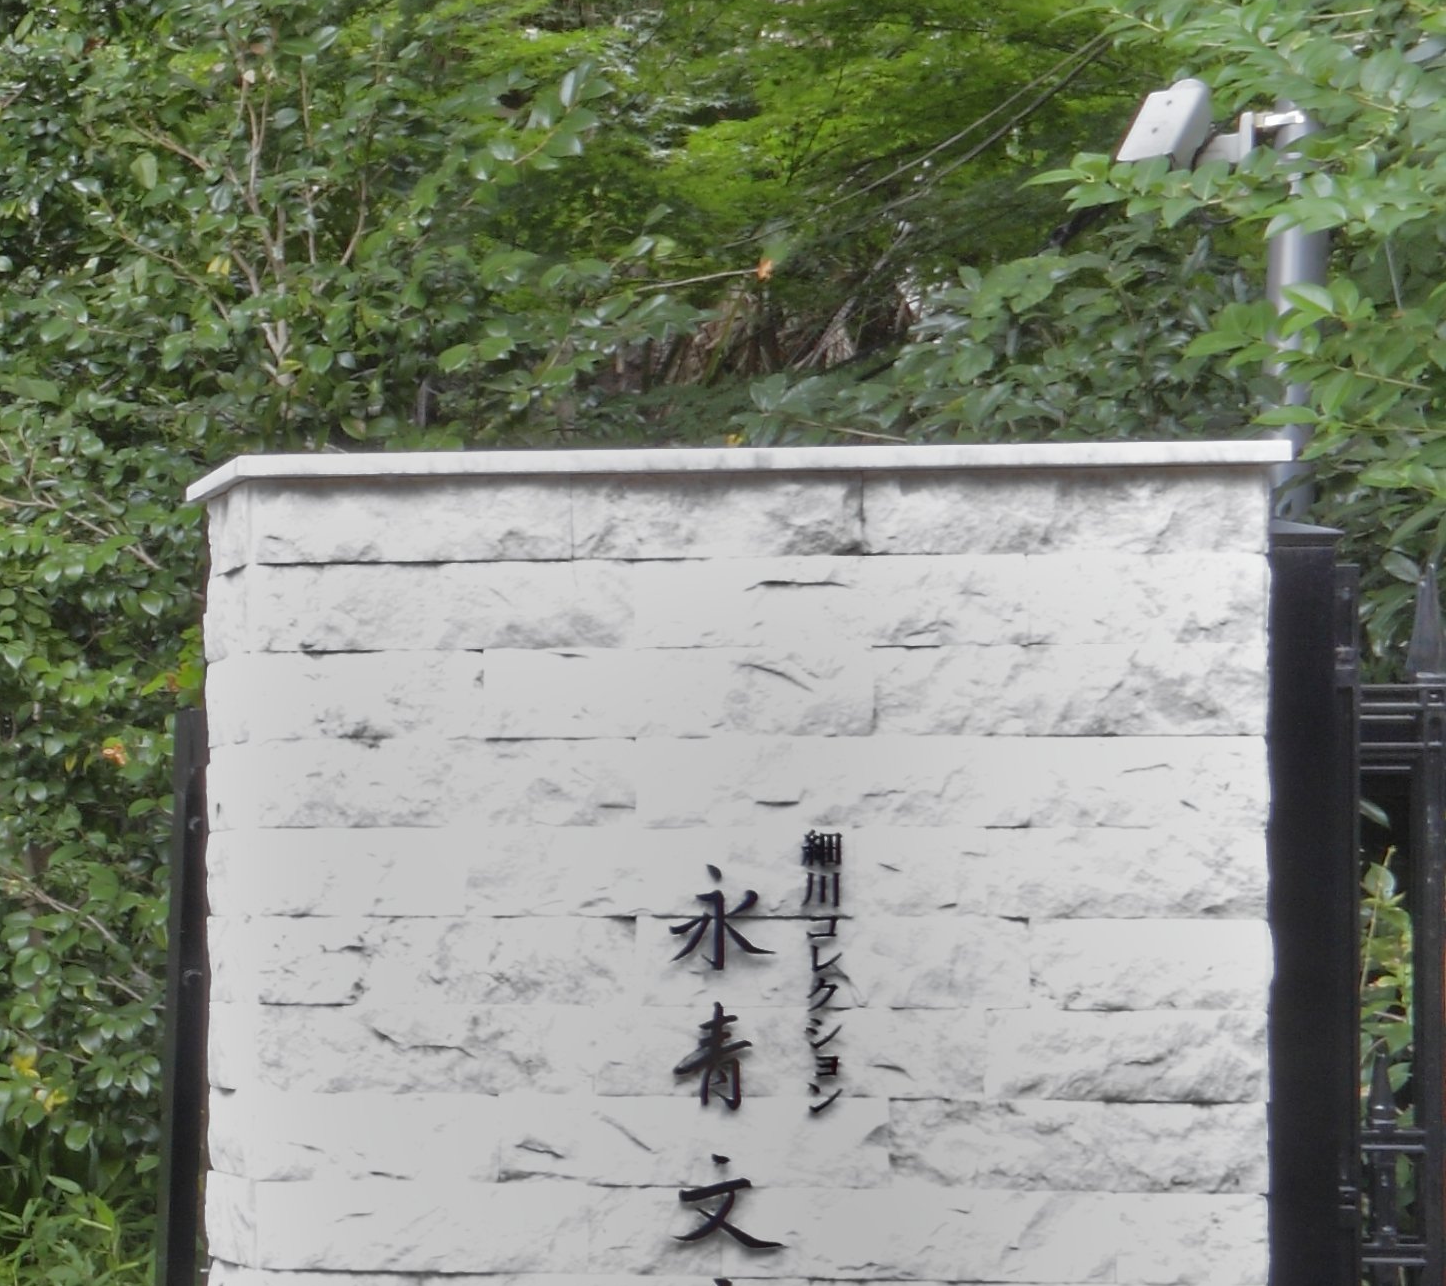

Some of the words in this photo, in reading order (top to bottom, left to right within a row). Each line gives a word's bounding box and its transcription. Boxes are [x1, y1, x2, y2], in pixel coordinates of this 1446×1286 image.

[802, 828, 843, 1117] 細川コレクション
